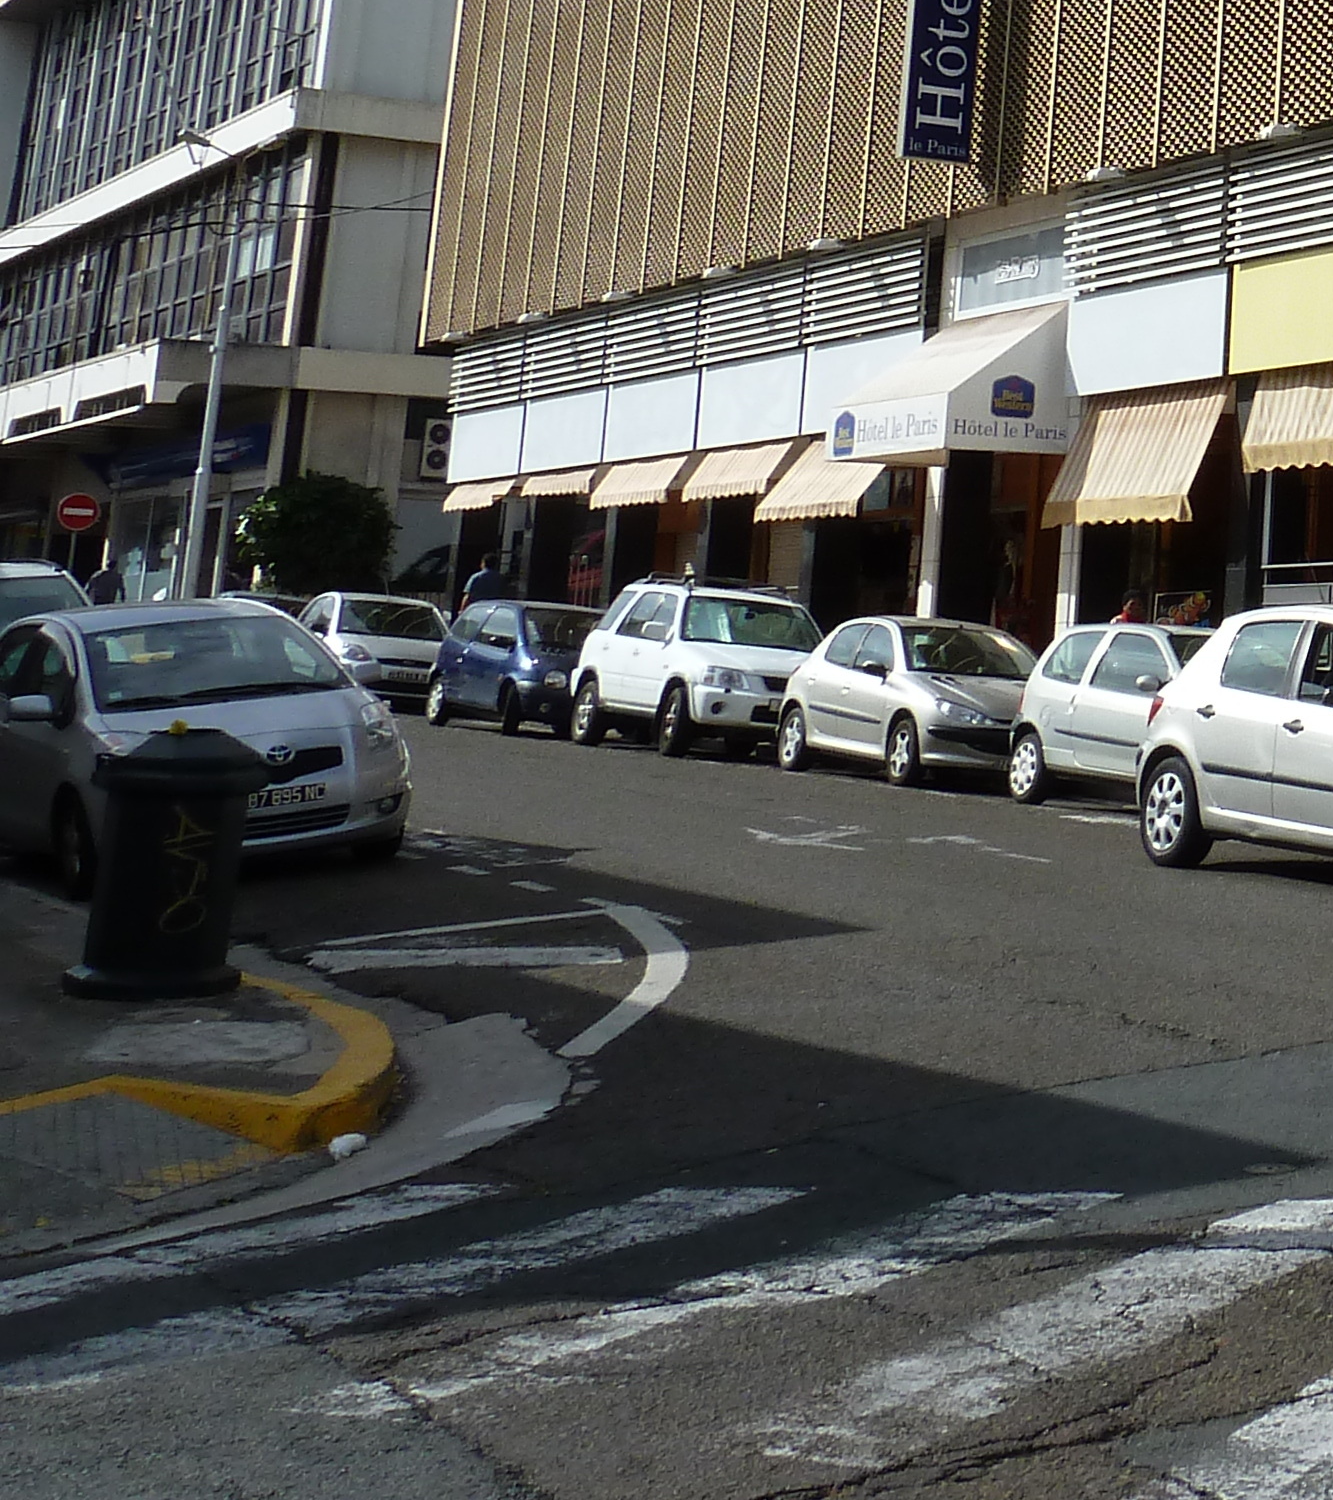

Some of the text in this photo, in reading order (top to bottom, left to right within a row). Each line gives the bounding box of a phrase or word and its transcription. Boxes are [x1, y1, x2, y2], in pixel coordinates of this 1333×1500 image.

[909, 136, 967, 158] le Paris
[857, 416, 888, 443] Hôtel
[892, 414, 902, 440] le
[906, 410, 939, 438] Paris
[953, 418, 1068, 440] Hôtel le Paris
